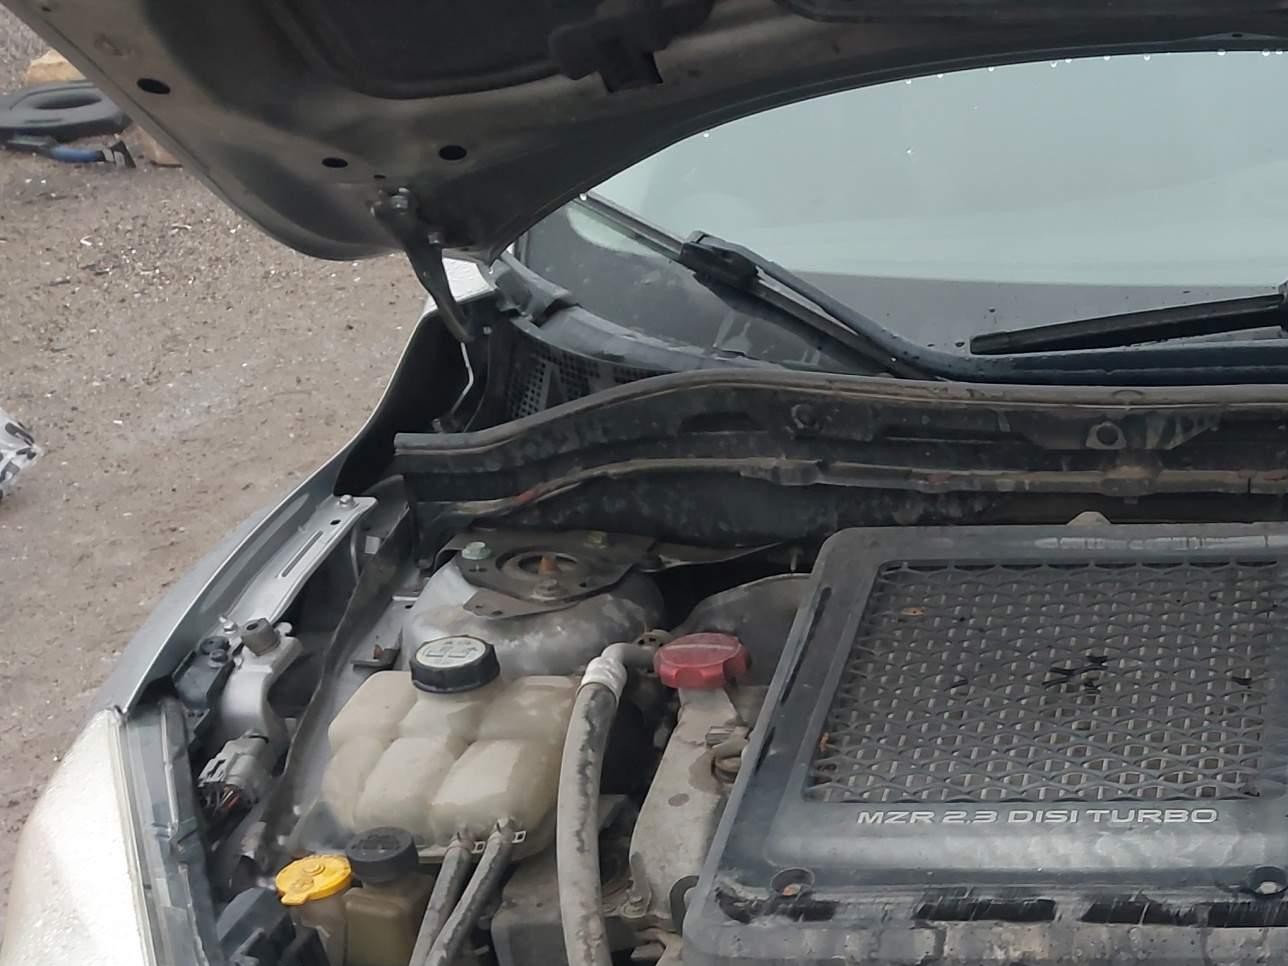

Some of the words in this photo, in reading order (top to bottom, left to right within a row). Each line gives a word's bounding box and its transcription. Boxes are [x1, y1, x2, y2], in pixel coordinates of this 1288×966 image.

[856, 810, 936, 825] MZR
[942, 809, 998, 825] 2.3
[1007, 809, 1079, 824] DISI
[1086, 808, 1218, 824] TURBO
